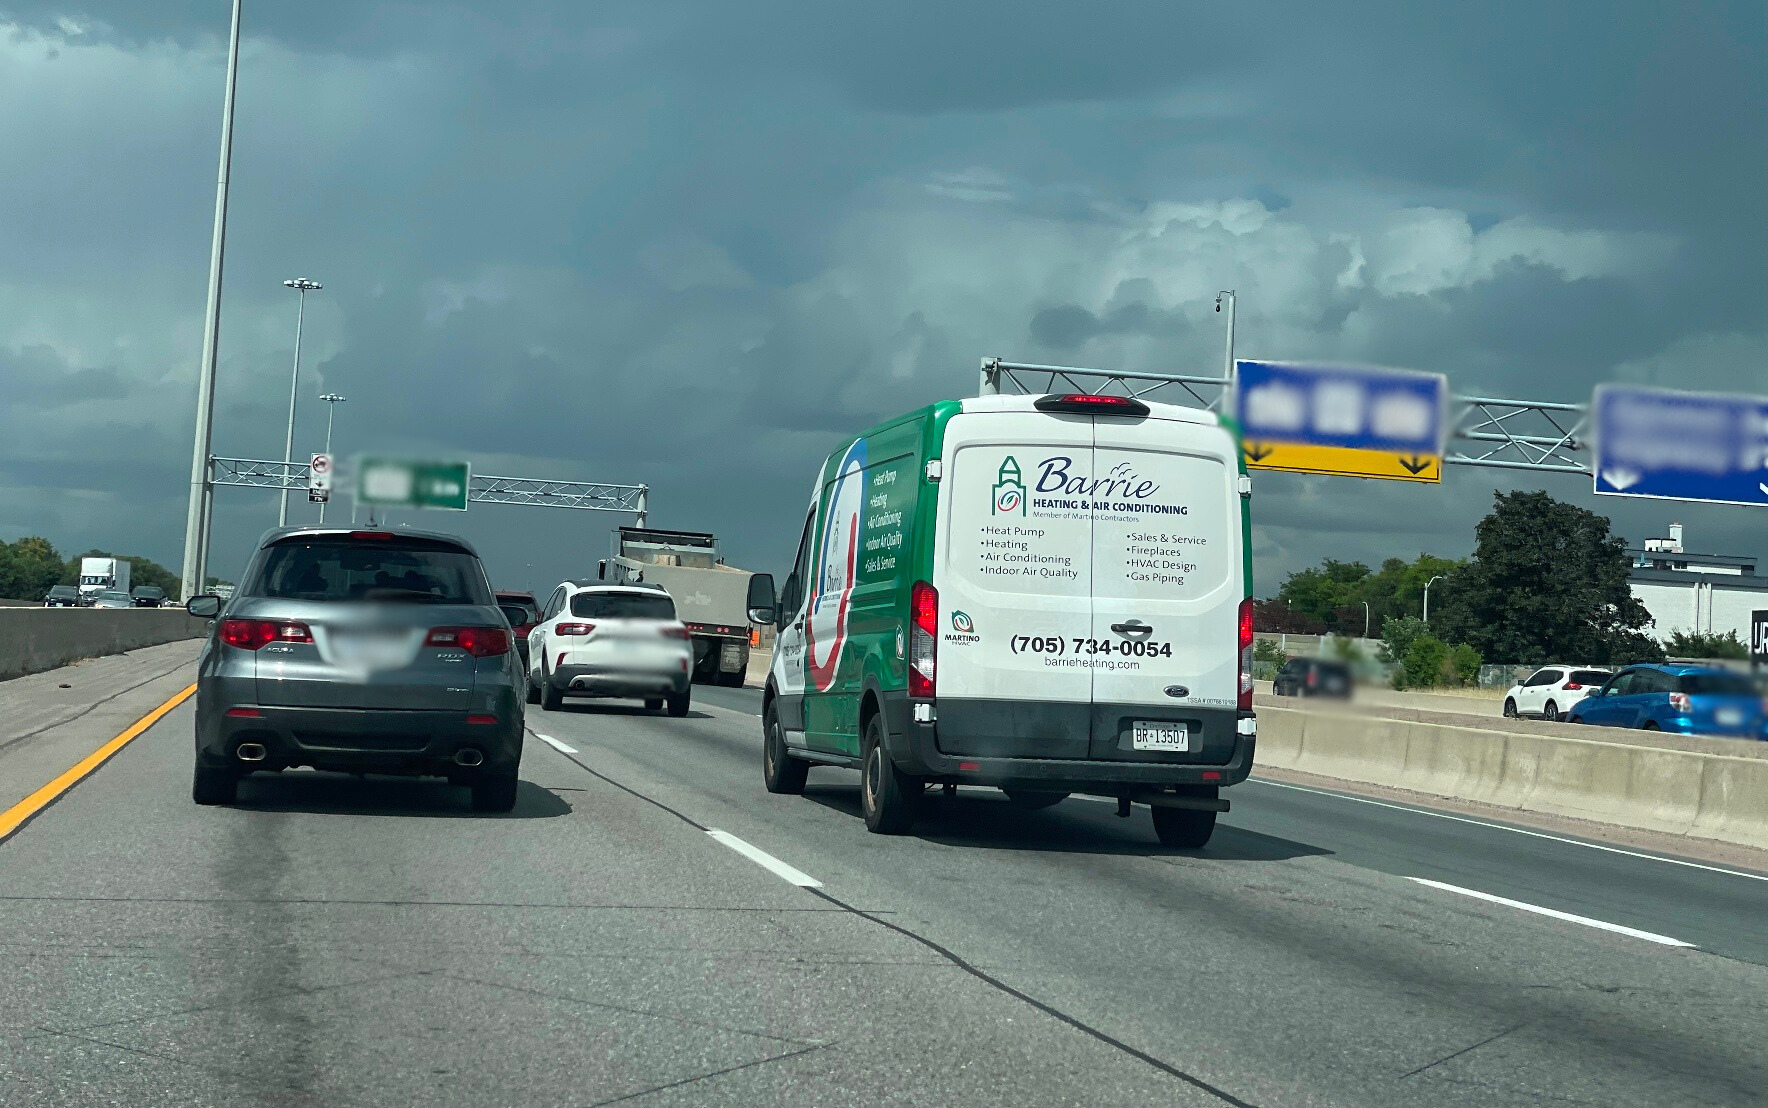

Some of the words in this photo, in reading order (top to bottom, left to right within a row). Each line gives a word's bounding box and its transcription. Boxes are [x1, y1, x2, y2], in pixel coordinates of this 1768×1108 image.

[1035, 456, 1160, 499] Barrie
[1033, 498, 1078, 509] HEATING
[1080, 500, 1090, 510] &
[1093, 501, 1110, 511] AIR
[1112, 502, 1188, 515] CONDITIONING
[875, 510, 902, 528] Conditioning
[1032, 511, 1062, 519] Member
[1063, 511, 1071, 519] of
[1100, 515, 1140, 523] Contractors
[986, 526, 1012, 535] Heat
[1014, 526, 1045, 538] Pump
[1131, 532, 1157, 542] Sales
[1160, 533, 1169, 543] &
[1171, 534, 1207, 545] Service
[985, 539, 1028, 552] Heating
[1131, 545, 1181, 557] Fireplaces
[984, 552, 1001, 561] Air
[1003, 552, 1071, 567] Conditioning
[1131, 558, 1160, 569] HVAC
[1162, 560, 1197, 573] Design
[985, 565, 1020, 575] Indoor
[1022, 567, 1037, 576] Air
[1040, 567, 1078, 580] Quality
[1130, 571, 1150, 581] Gas
[1152, 572, 1184, 586] Piping
[944, 634, 980, 643] MARTINO
[1010, 634, 1065, 656] (705)
[1072, 638, 1173, 658] 734-0054
[1044, 656, 1140, 671] barrieheating.com
[1136, 727, 1148, 743] BR
[1155, 728, 1185, 744] 13507
